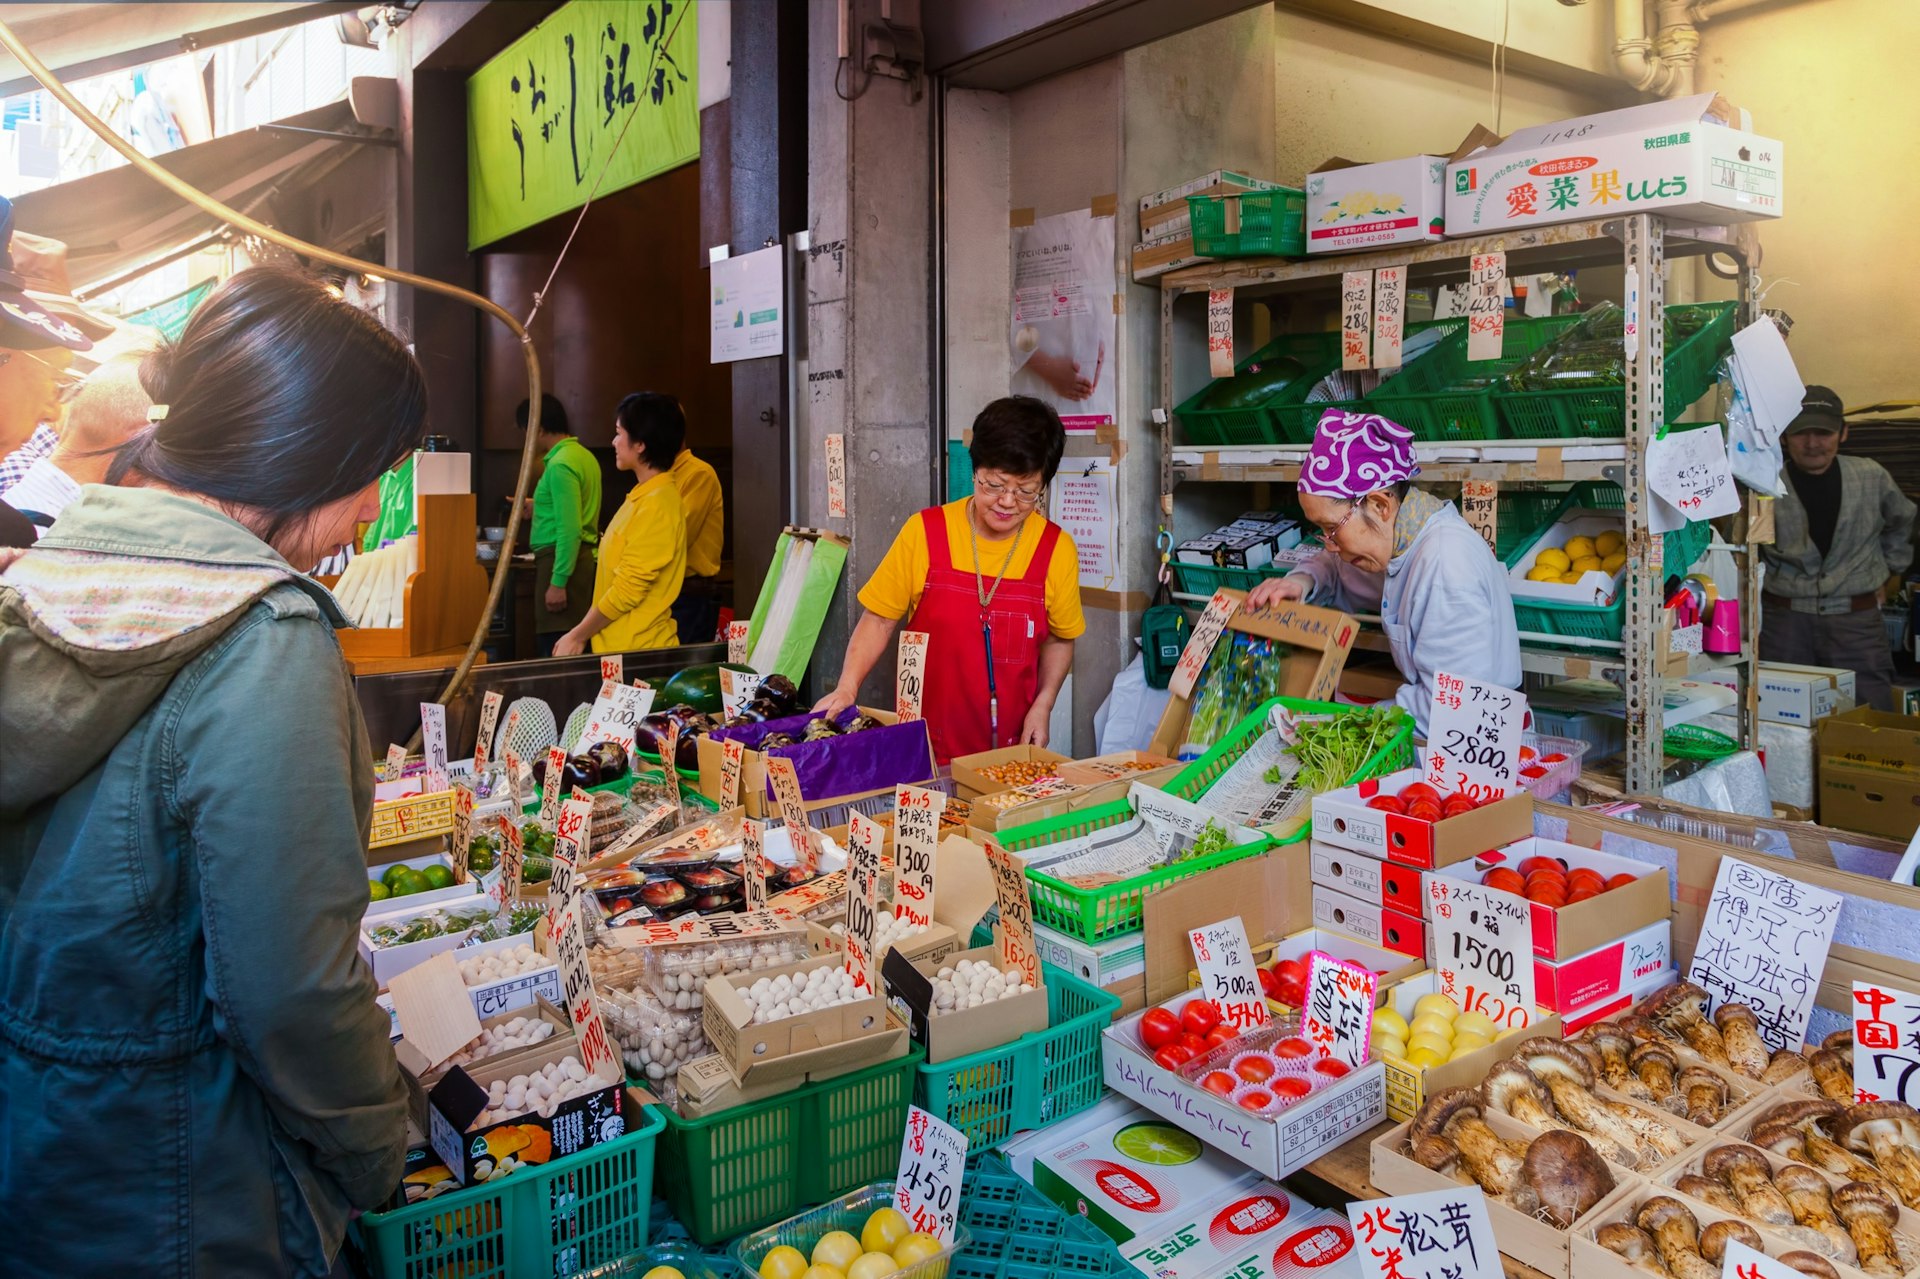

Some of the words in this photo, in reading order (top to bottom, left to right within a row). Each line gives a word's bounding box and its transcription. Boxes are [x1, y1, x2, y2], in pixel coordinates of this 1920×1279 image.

[1540, 124, 1596, 145] 1148
[1643, 132, 1691, 150] 秋田県産
[1539, 159, 1590, 176] 秋田花まるっ
[1626, 176, 1688, 201] ししとう
[1471, 267, 1504, 286] ししとう
[1438, 673, 1464, 693] 静岡
[1482, 708, 1507, 728] トマト
[1476, 725, 1499, 743] 1箱
[1430, 881, 1453, 919] 静岡
[1452, 888, 1529, 926] スイートマイルド
[1470, 910, 1500, 937] 1箱
[1633, 960, 1662, 980] TOMATO
[1853, 988, 1898, 1050] 中国
[908, 1110, 928, 1157] 静岡
[1290, 1136, 1299, 1147] 2S
[1395, 1202, 1478, 1272] 松茸
